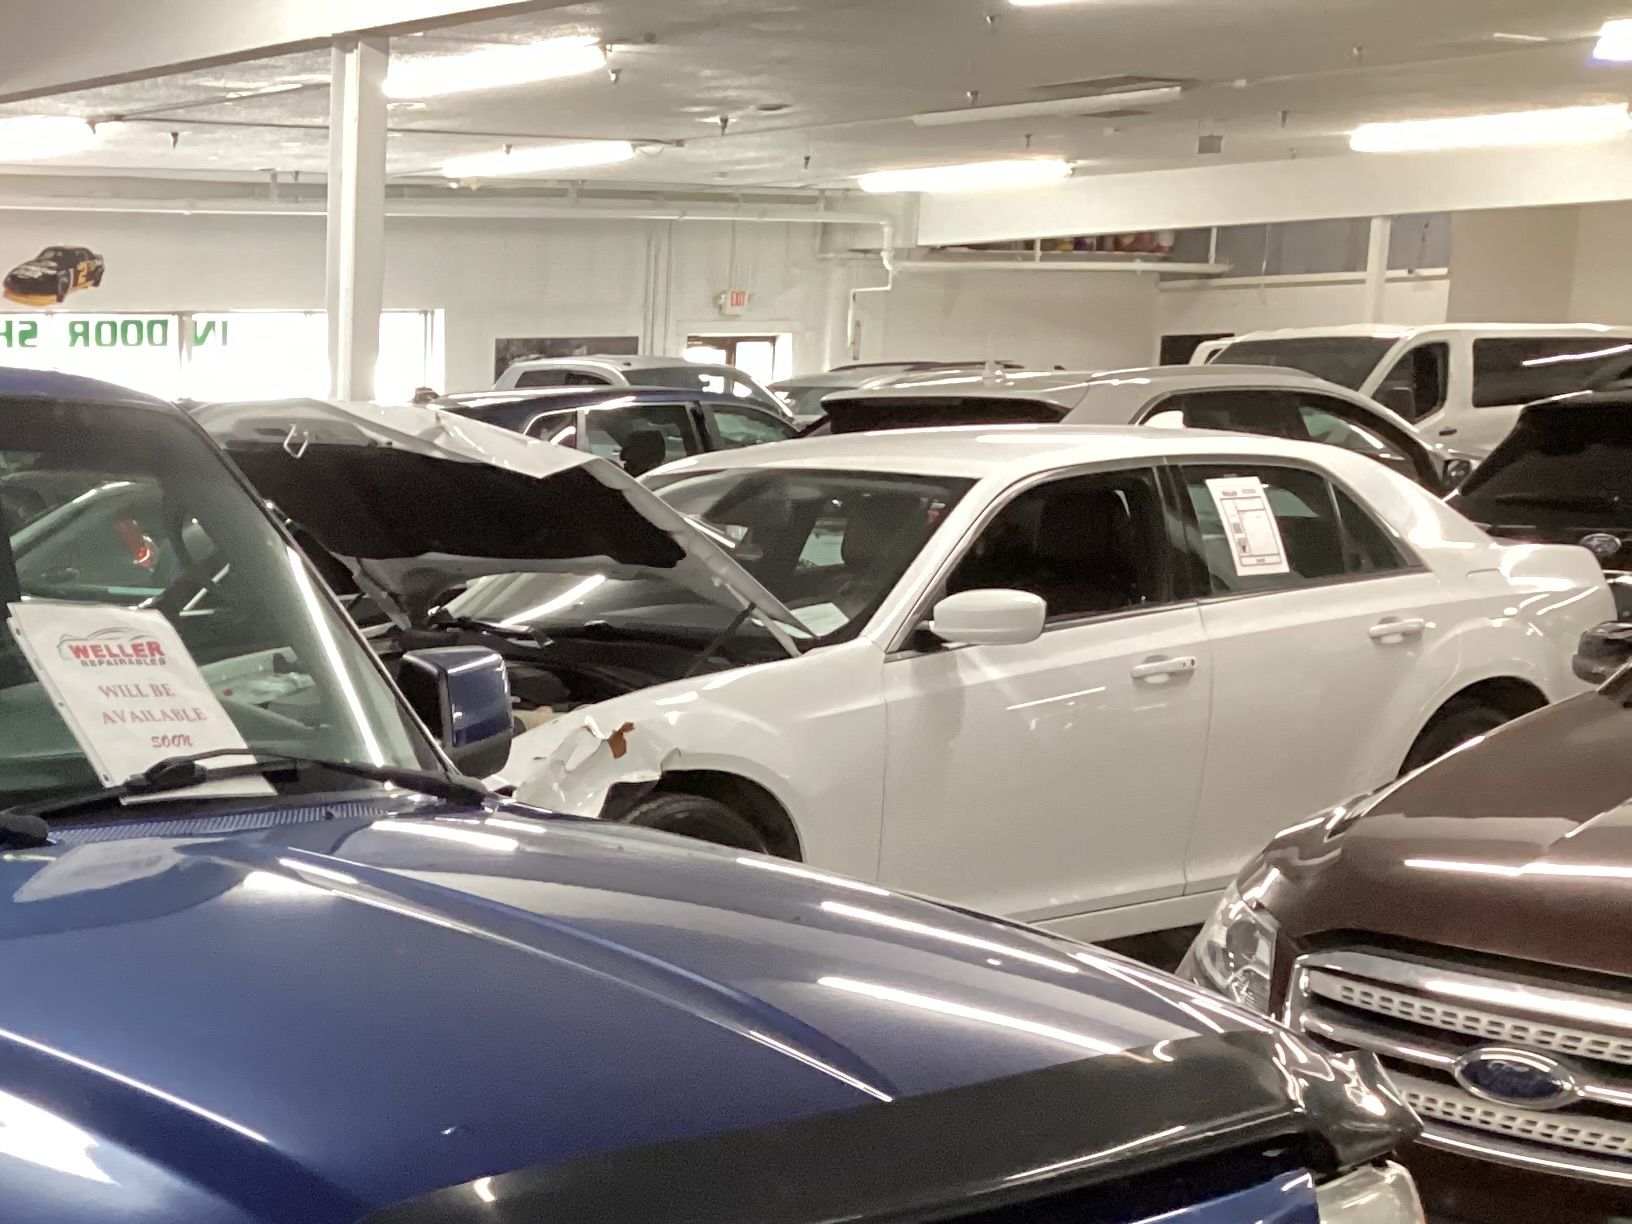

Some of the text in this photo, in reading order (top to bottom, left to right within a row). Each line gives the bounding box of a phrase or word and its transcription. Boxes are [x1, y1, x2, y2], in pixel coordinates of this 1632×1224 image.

[68, 640, 166, 660] WELLER
[79, 657, 167, 668] REPAIRABLES
[97, 682, 177, 699] WILL BE
[102, 707, 208, 726] AVAILABLE
